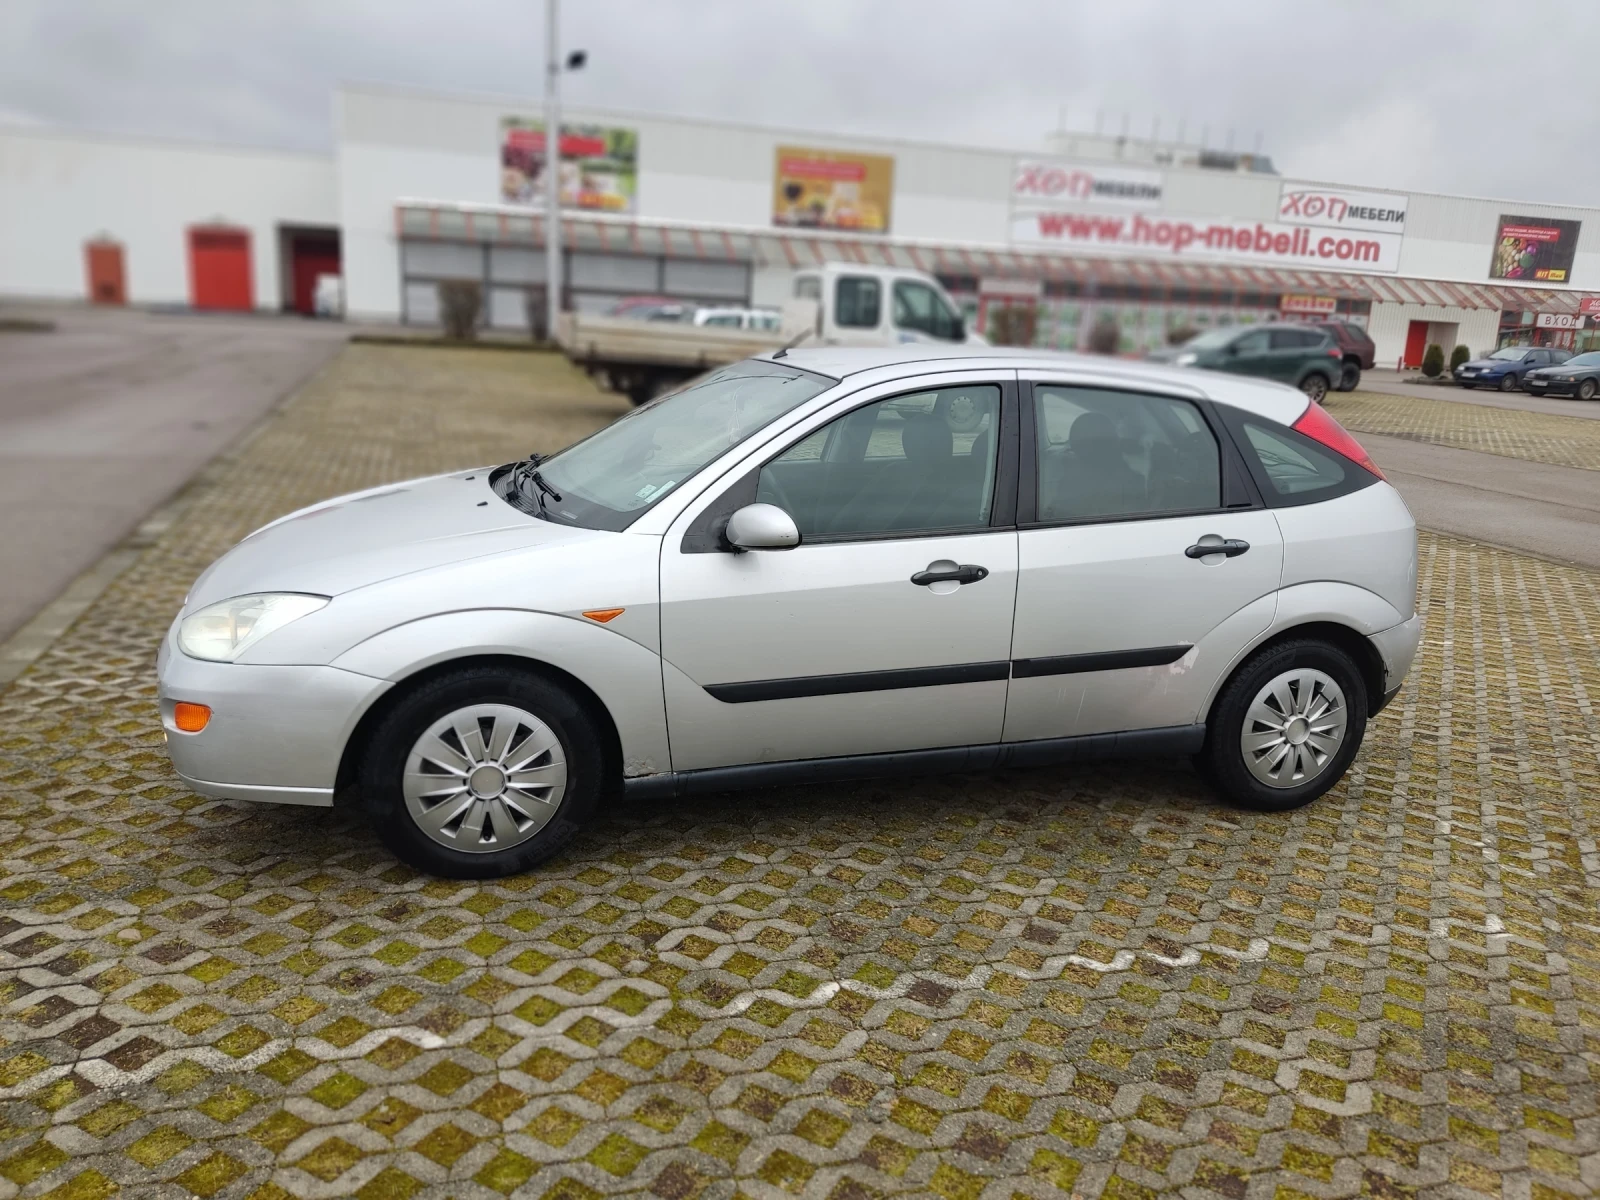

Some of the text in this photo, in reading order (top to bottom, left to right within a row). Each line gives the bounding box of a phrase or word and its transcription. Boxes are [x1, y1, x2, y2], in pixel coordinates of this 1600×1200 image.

[1281, 192, 1405, 223] ХОП МЕБЕЛИ
[1038, 212, 1381, 262] www.hop-mebeli.com
[1545, 316, 1577, 328] ВХОД
